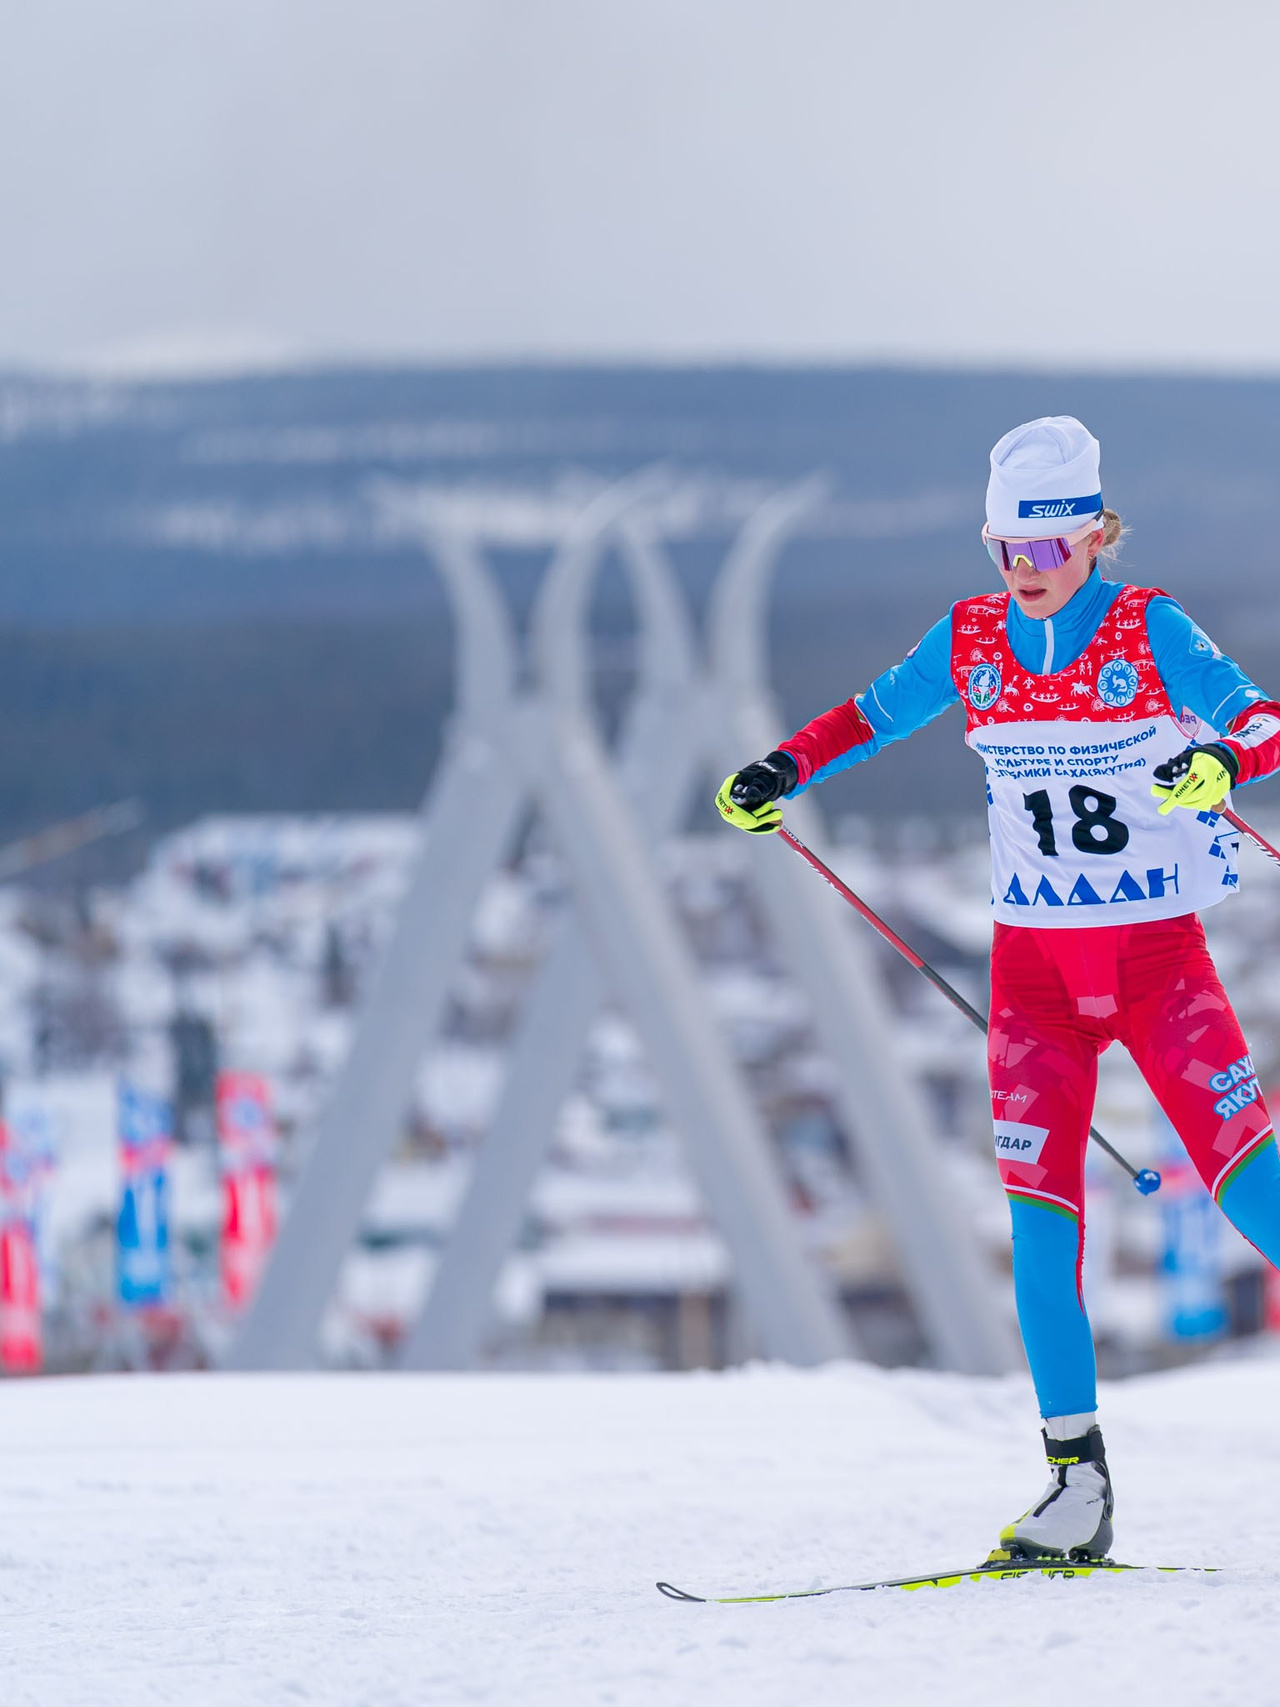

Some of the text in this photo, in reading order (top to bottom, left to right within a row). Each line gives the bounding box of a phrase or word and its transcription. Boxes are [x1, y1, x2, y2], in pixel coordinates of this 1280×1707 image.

[1028, 499, 1076, 518] SWIX
[1047, 746, 1066, 756] ПО
[1069, 725, 1157, 756] ФИЗИЧЕСКОЙ
[1054, 758, 1065, 767] И
[1067, 754, 1119, 767] СПОРТУ
[1022, 784, 1130, 857] 18
[991, 1090, 1028, 1103] TEAM
[995, 1135, 1032, 1151] ГДАР
